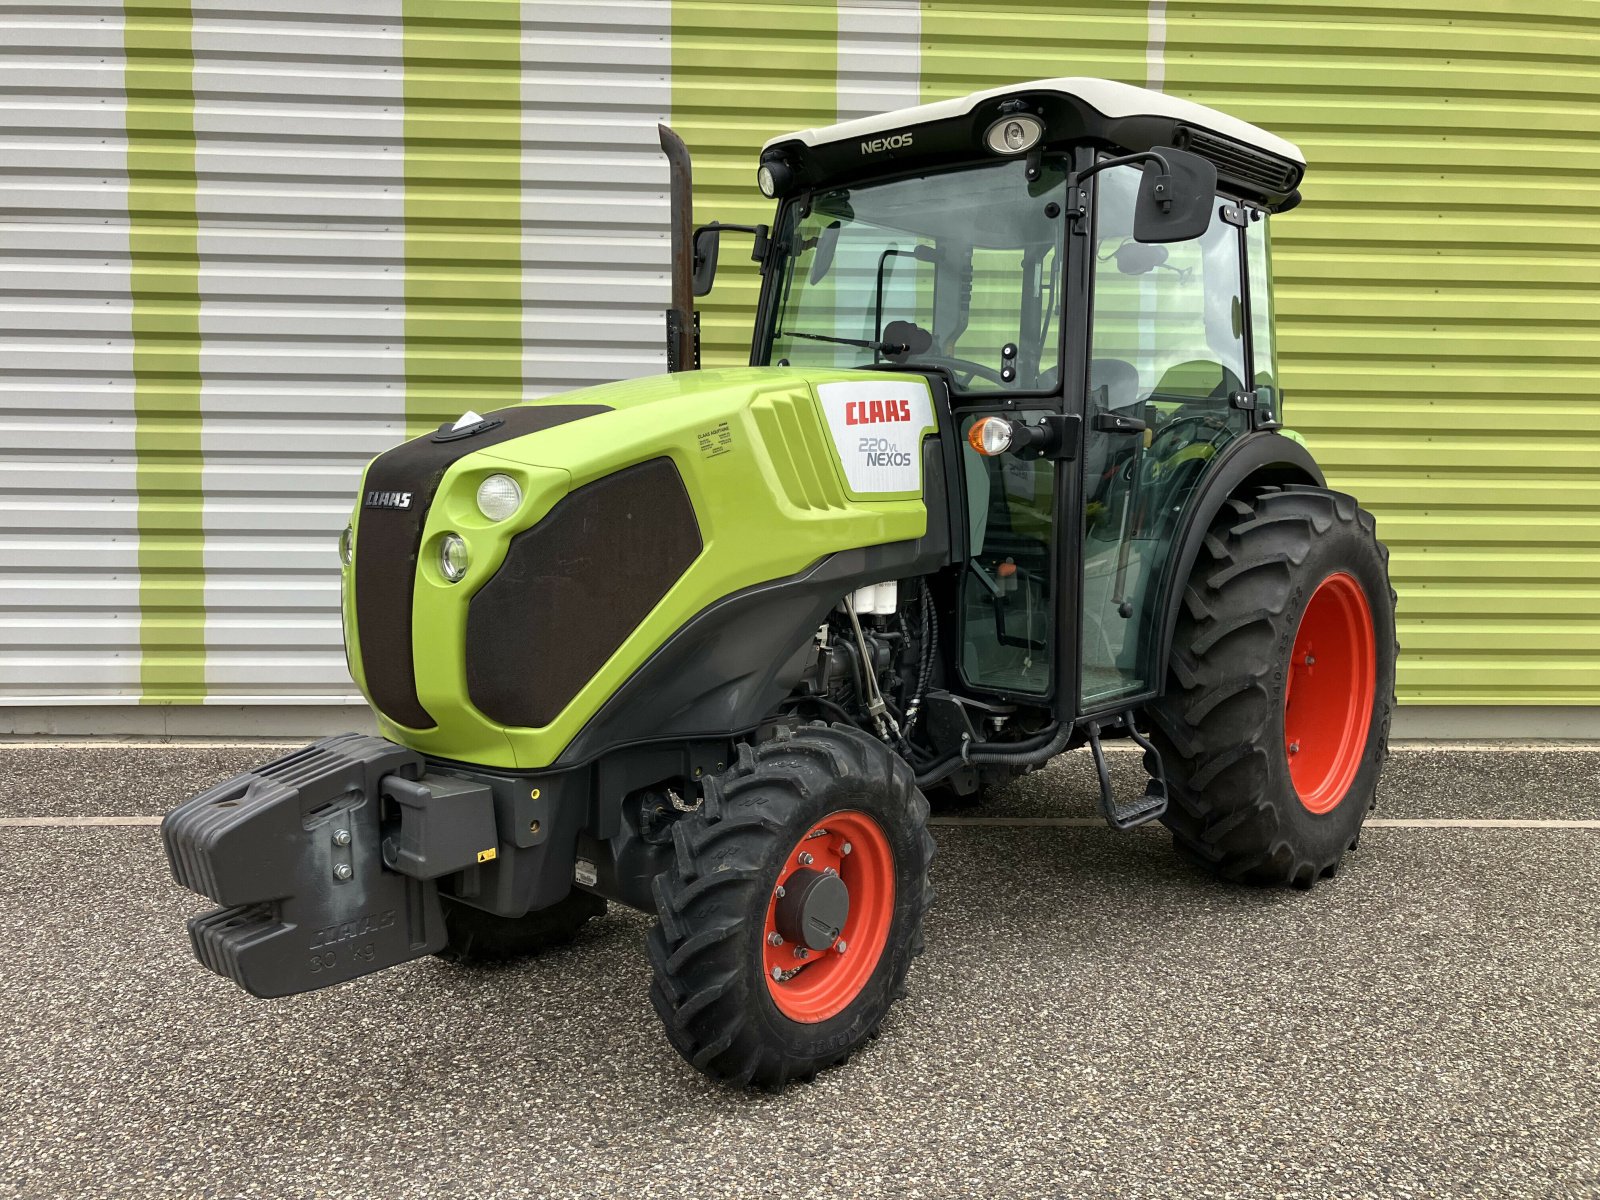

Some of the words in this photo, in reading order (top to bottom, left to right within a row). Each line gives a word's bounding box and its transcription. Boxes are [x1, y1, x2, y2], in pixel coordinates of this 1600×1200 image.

[861, 132, 913, 154] NEXOS
[846, 400, 910, 425] CLAAS
[867, 453, 911, 466] NEXOS
[365, 491, 412, 508] CLAAS
